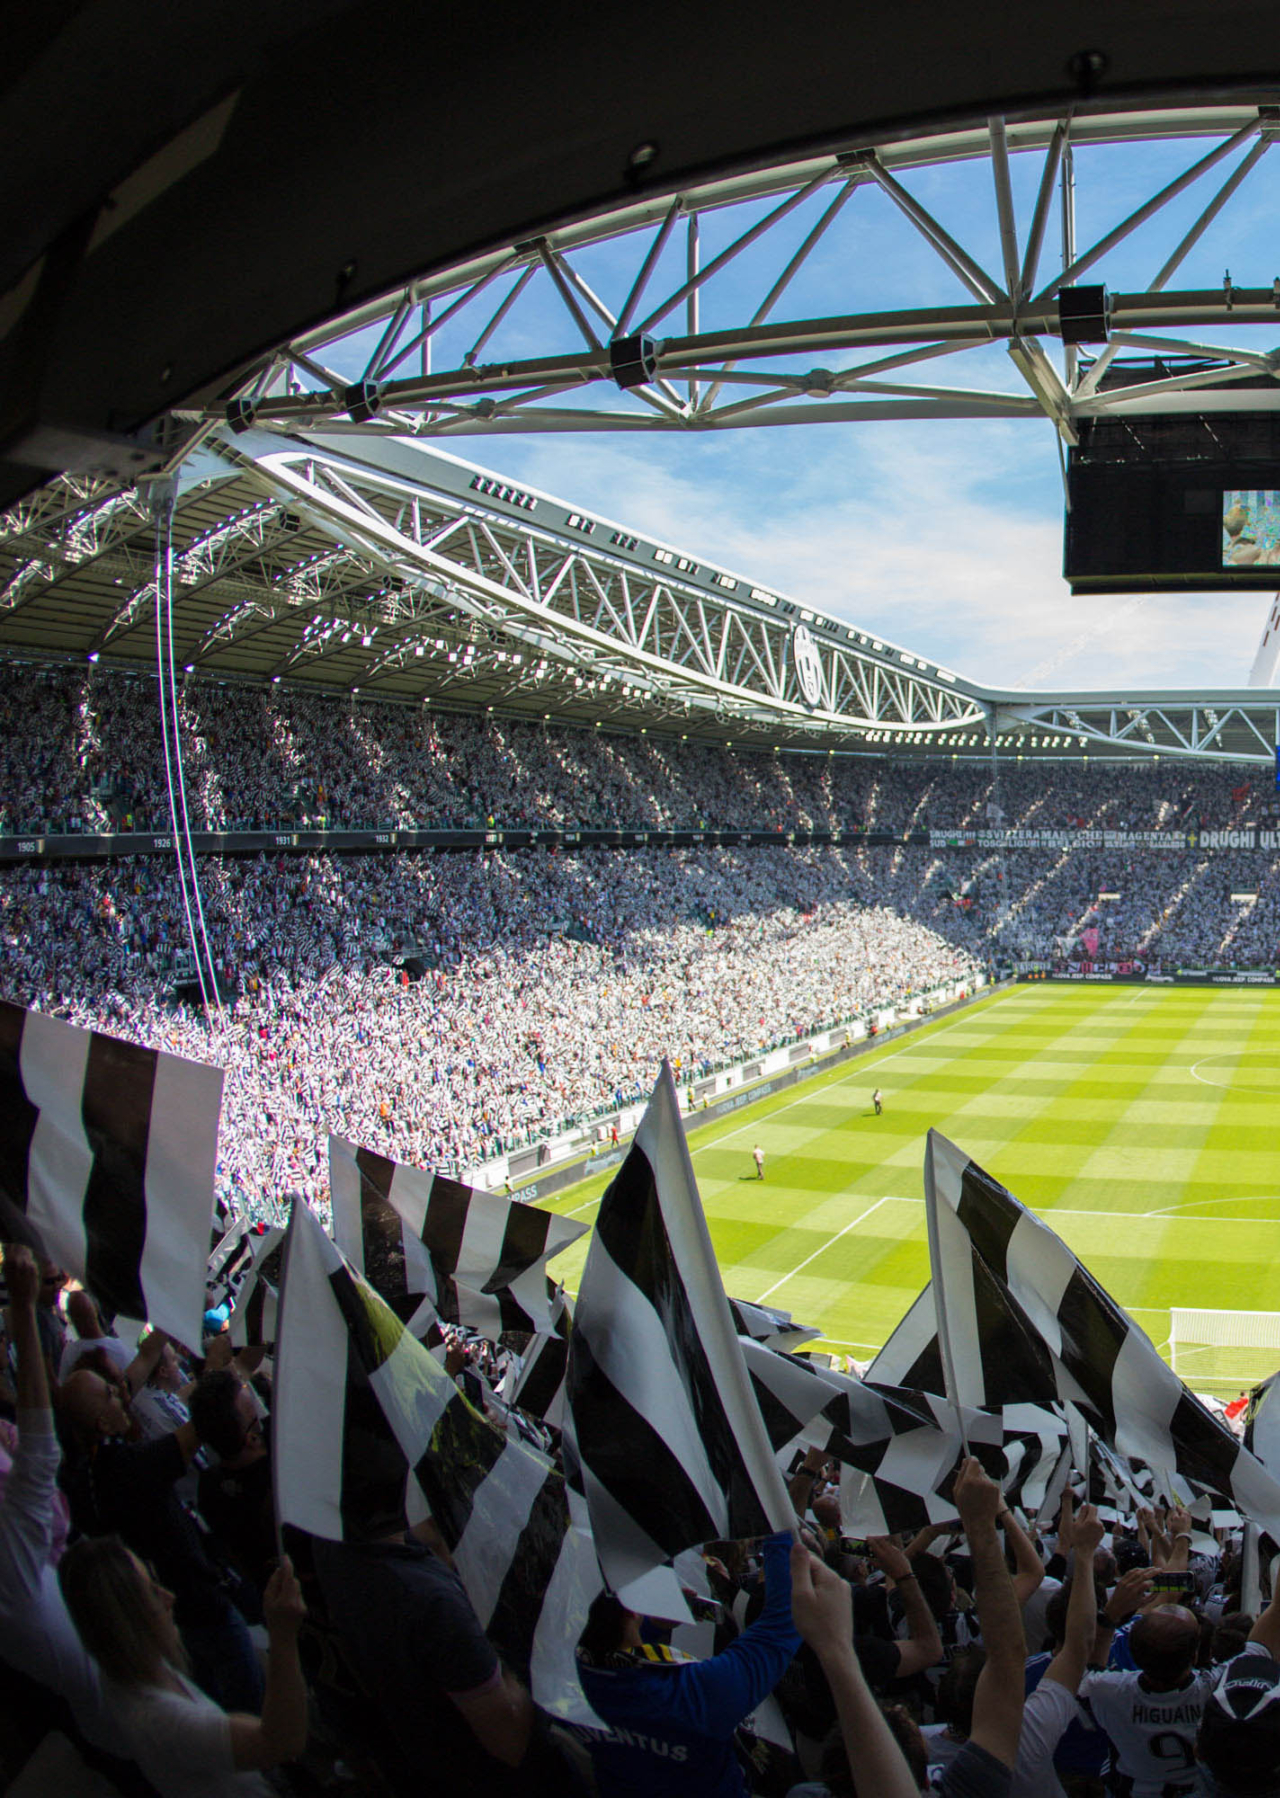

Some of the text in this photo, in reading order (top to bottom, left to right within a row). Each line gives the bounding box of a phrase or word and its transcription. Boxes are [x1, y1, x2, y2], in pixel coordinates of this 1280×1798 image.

[986, 830, 1039, 839] SVIZZERA
[1117, 831, 1172, 840] MAGENTA
[153, 838, 171, 848] 1926
[929, 840, 946, 848] SUD
[1201, 831, 1255, 849] DRUGHI
[1132, 1704, 1202, 1724] HIGUAIN
[1149, 1731, 1196, 1773] 9
